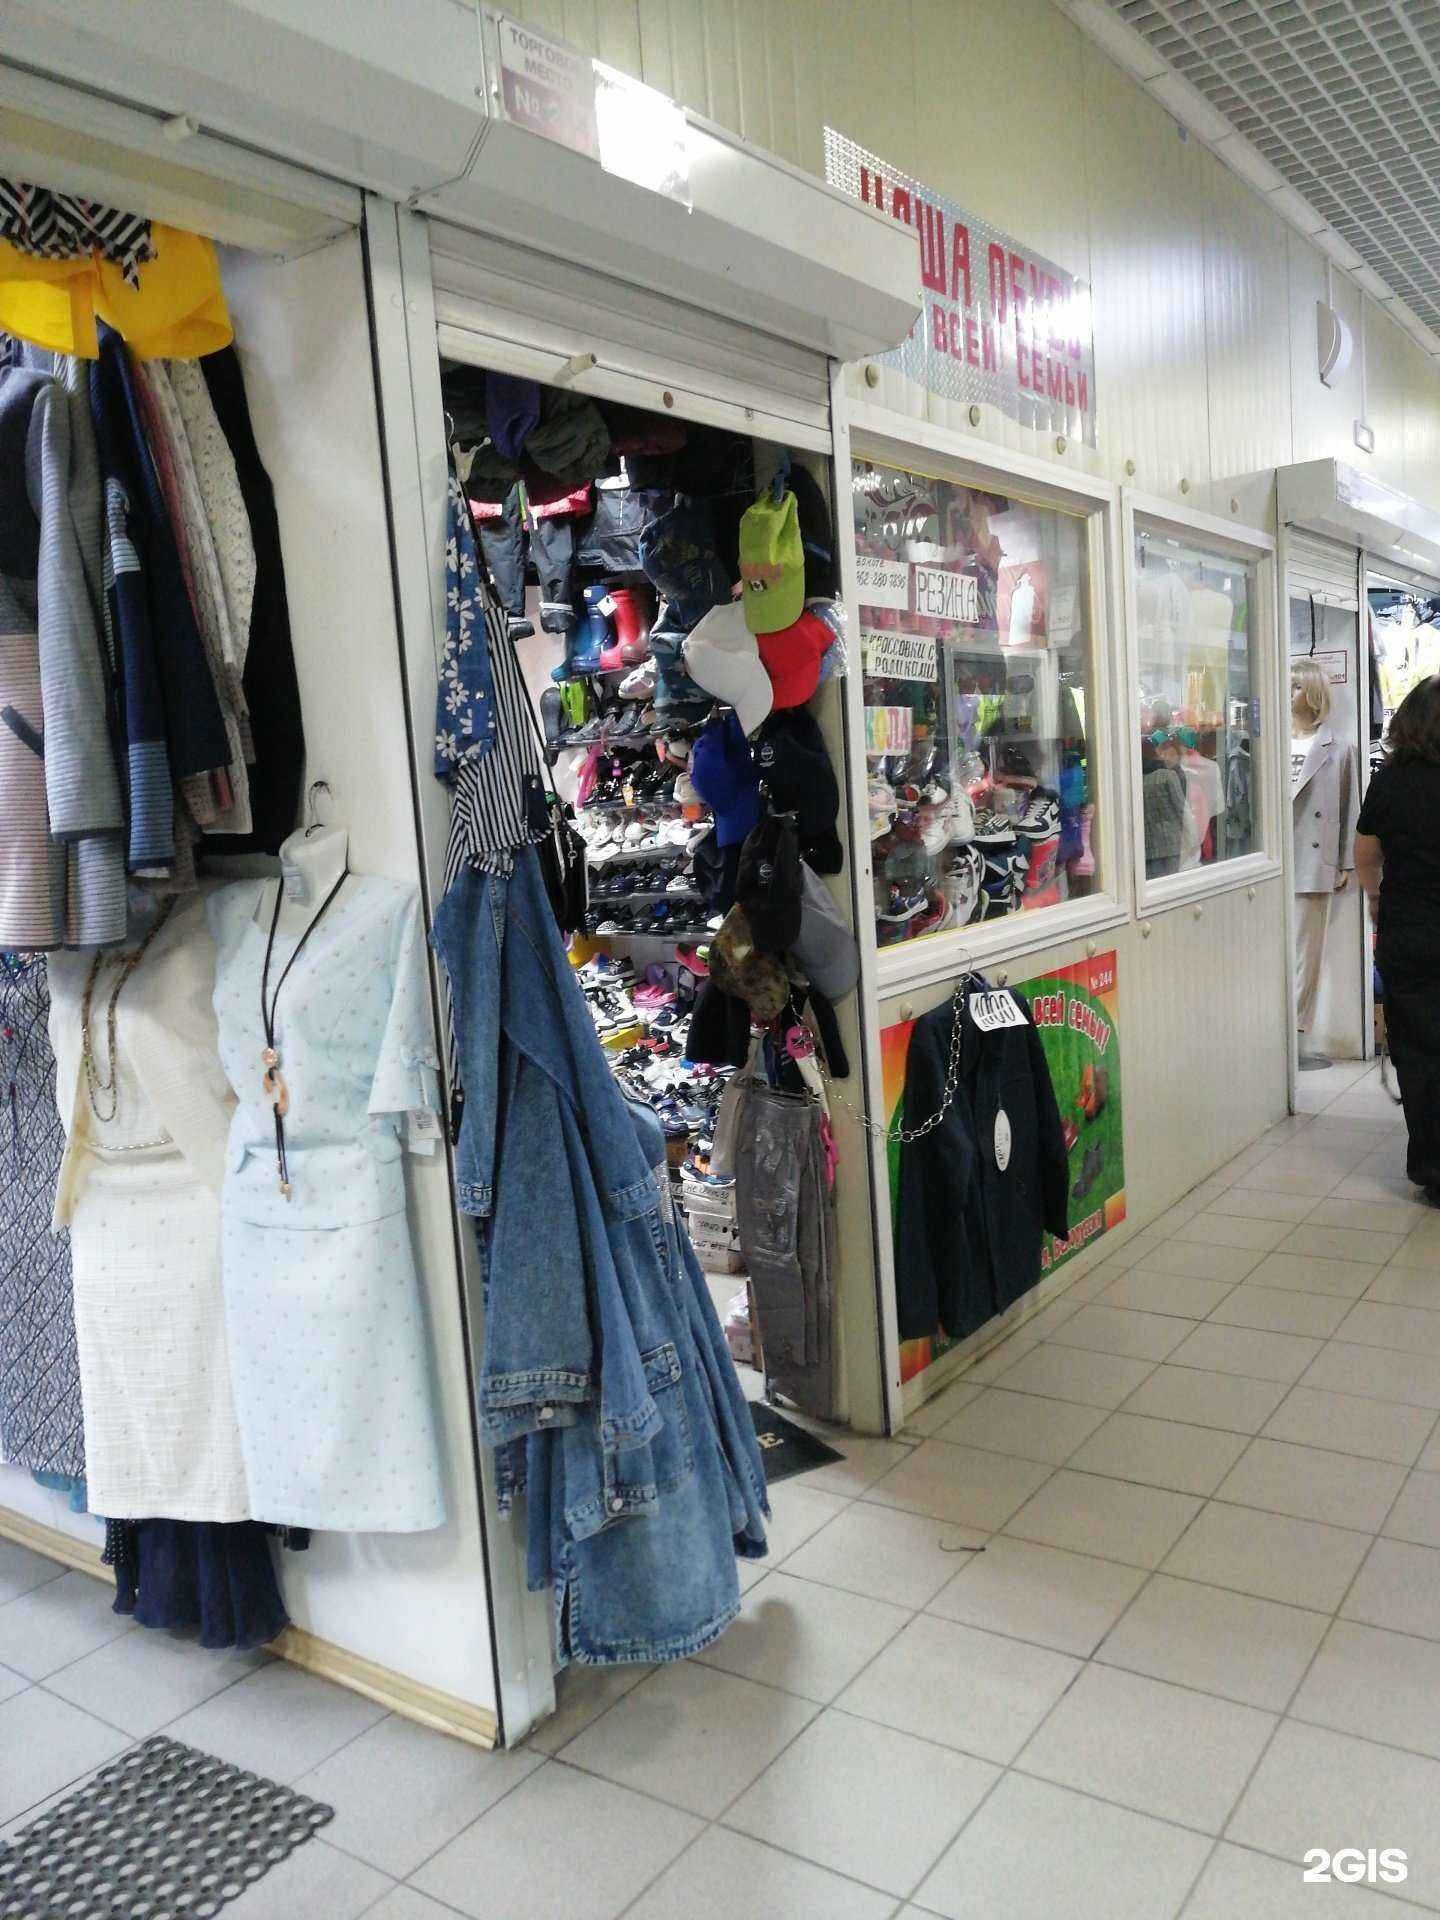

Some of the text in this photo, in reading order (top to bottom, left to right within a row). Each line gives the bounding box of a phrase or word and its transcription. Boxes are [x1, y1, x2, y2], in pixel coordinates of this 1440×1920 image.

[1016, 343, 1088, 413] СЕМЬИ
[917, 572, 977, 621] РЕЗИНА
[1033, 991, 1111, 1055] всей семьи!
